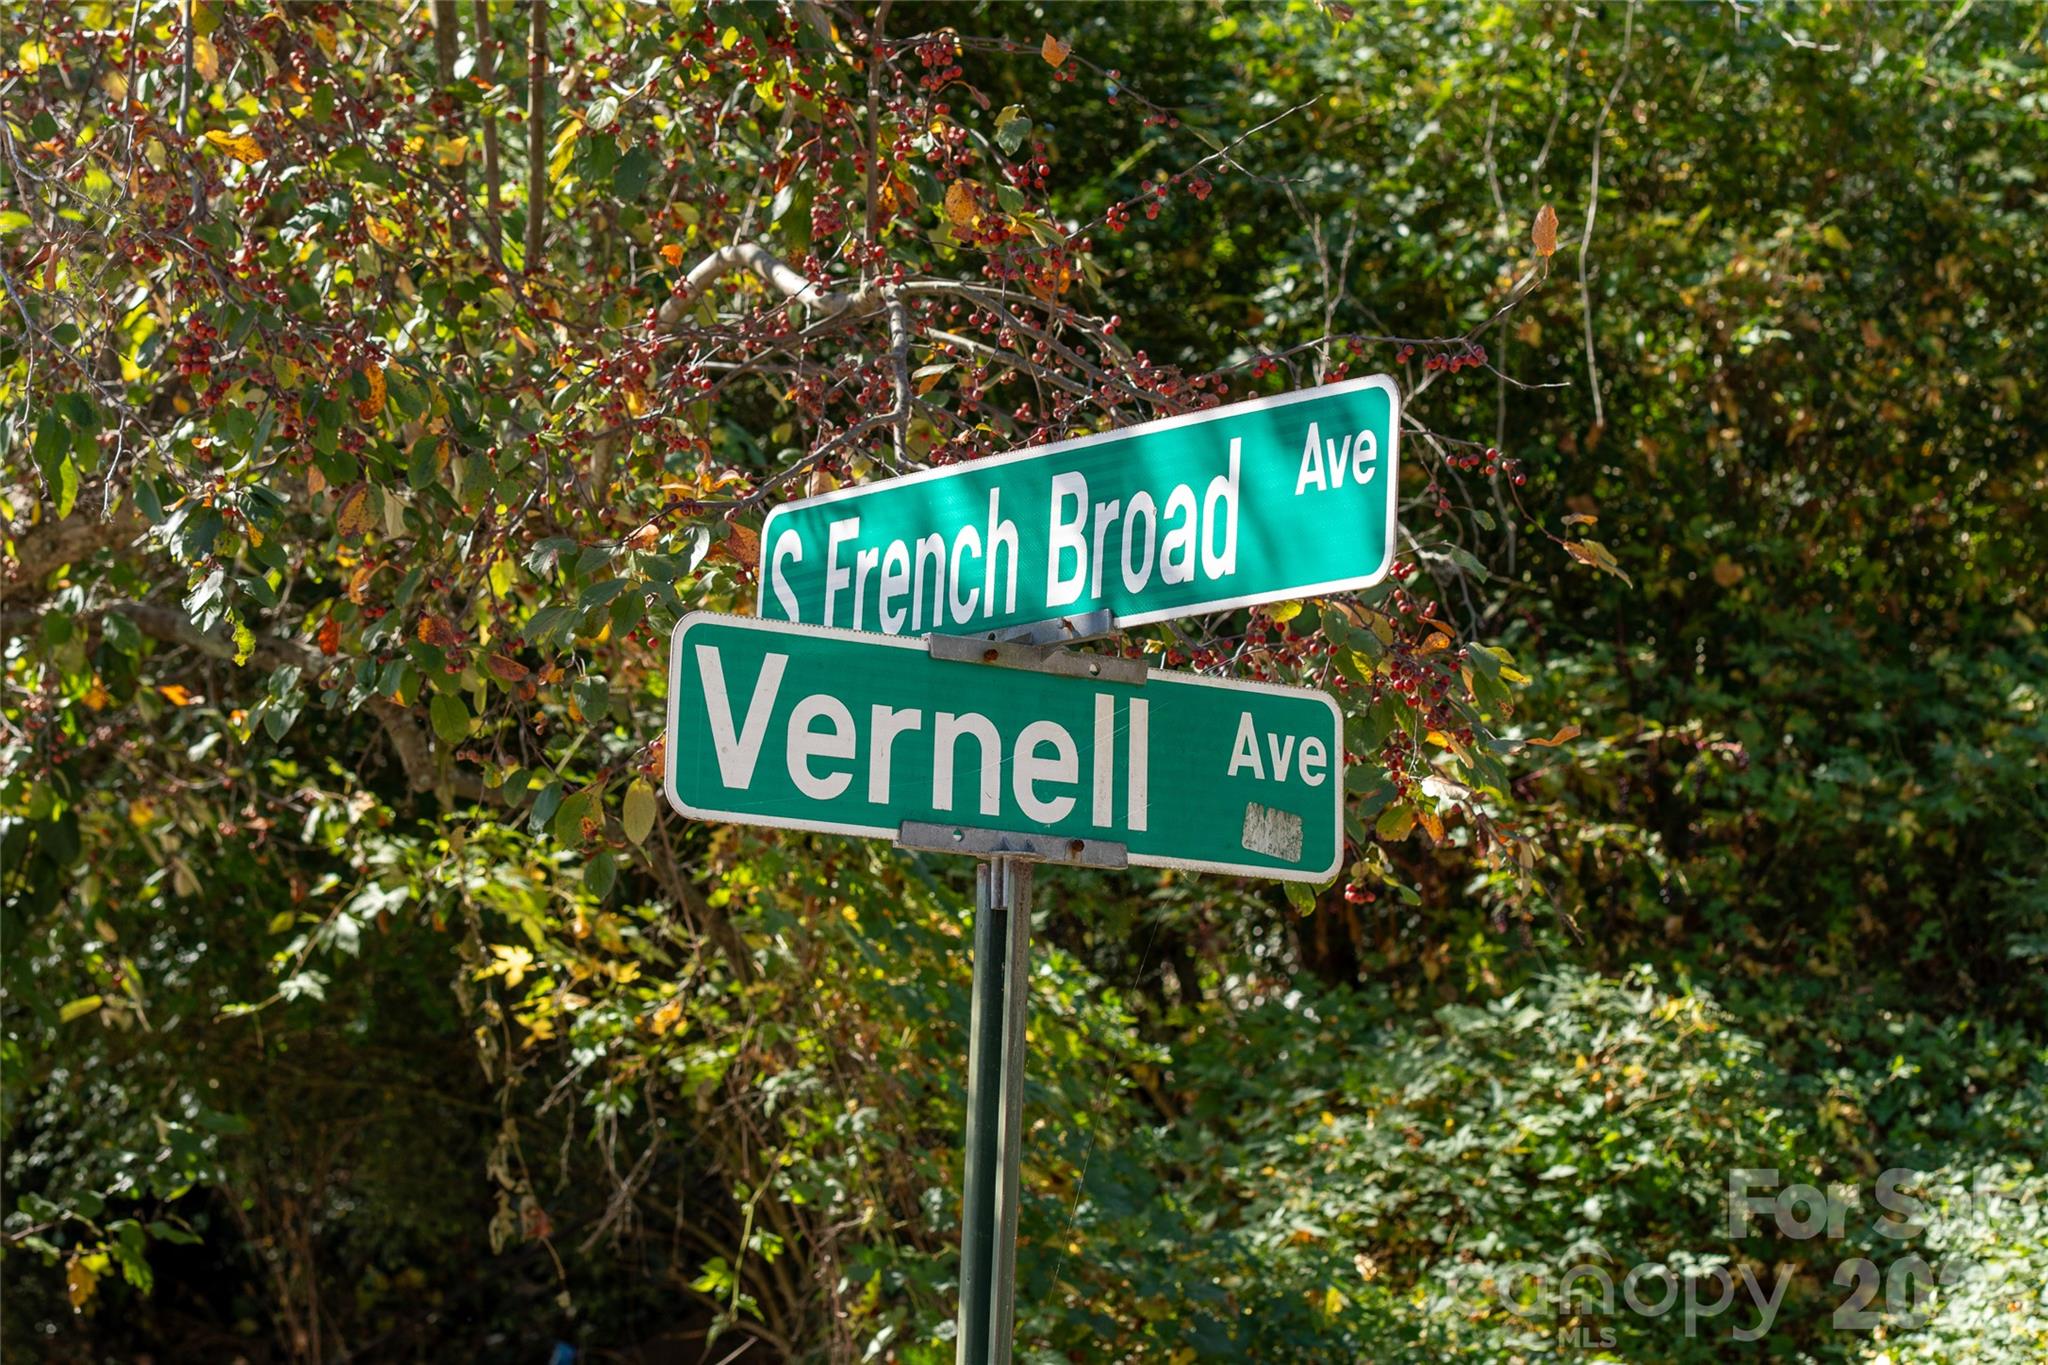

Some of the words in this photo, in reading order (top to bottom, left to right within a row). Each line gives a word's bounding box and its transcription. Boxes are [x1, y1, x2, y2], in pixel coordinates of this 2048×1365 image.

[771, 529, 803, 623] S
[824, 487, 1019, 634] French
[1047, 437, 1242, 607] Broad
[1296, 421, 1377, 495] Ave
[696, 644, 1149, 832] Vernell
[1227, 712, 1327, 787] Ave
